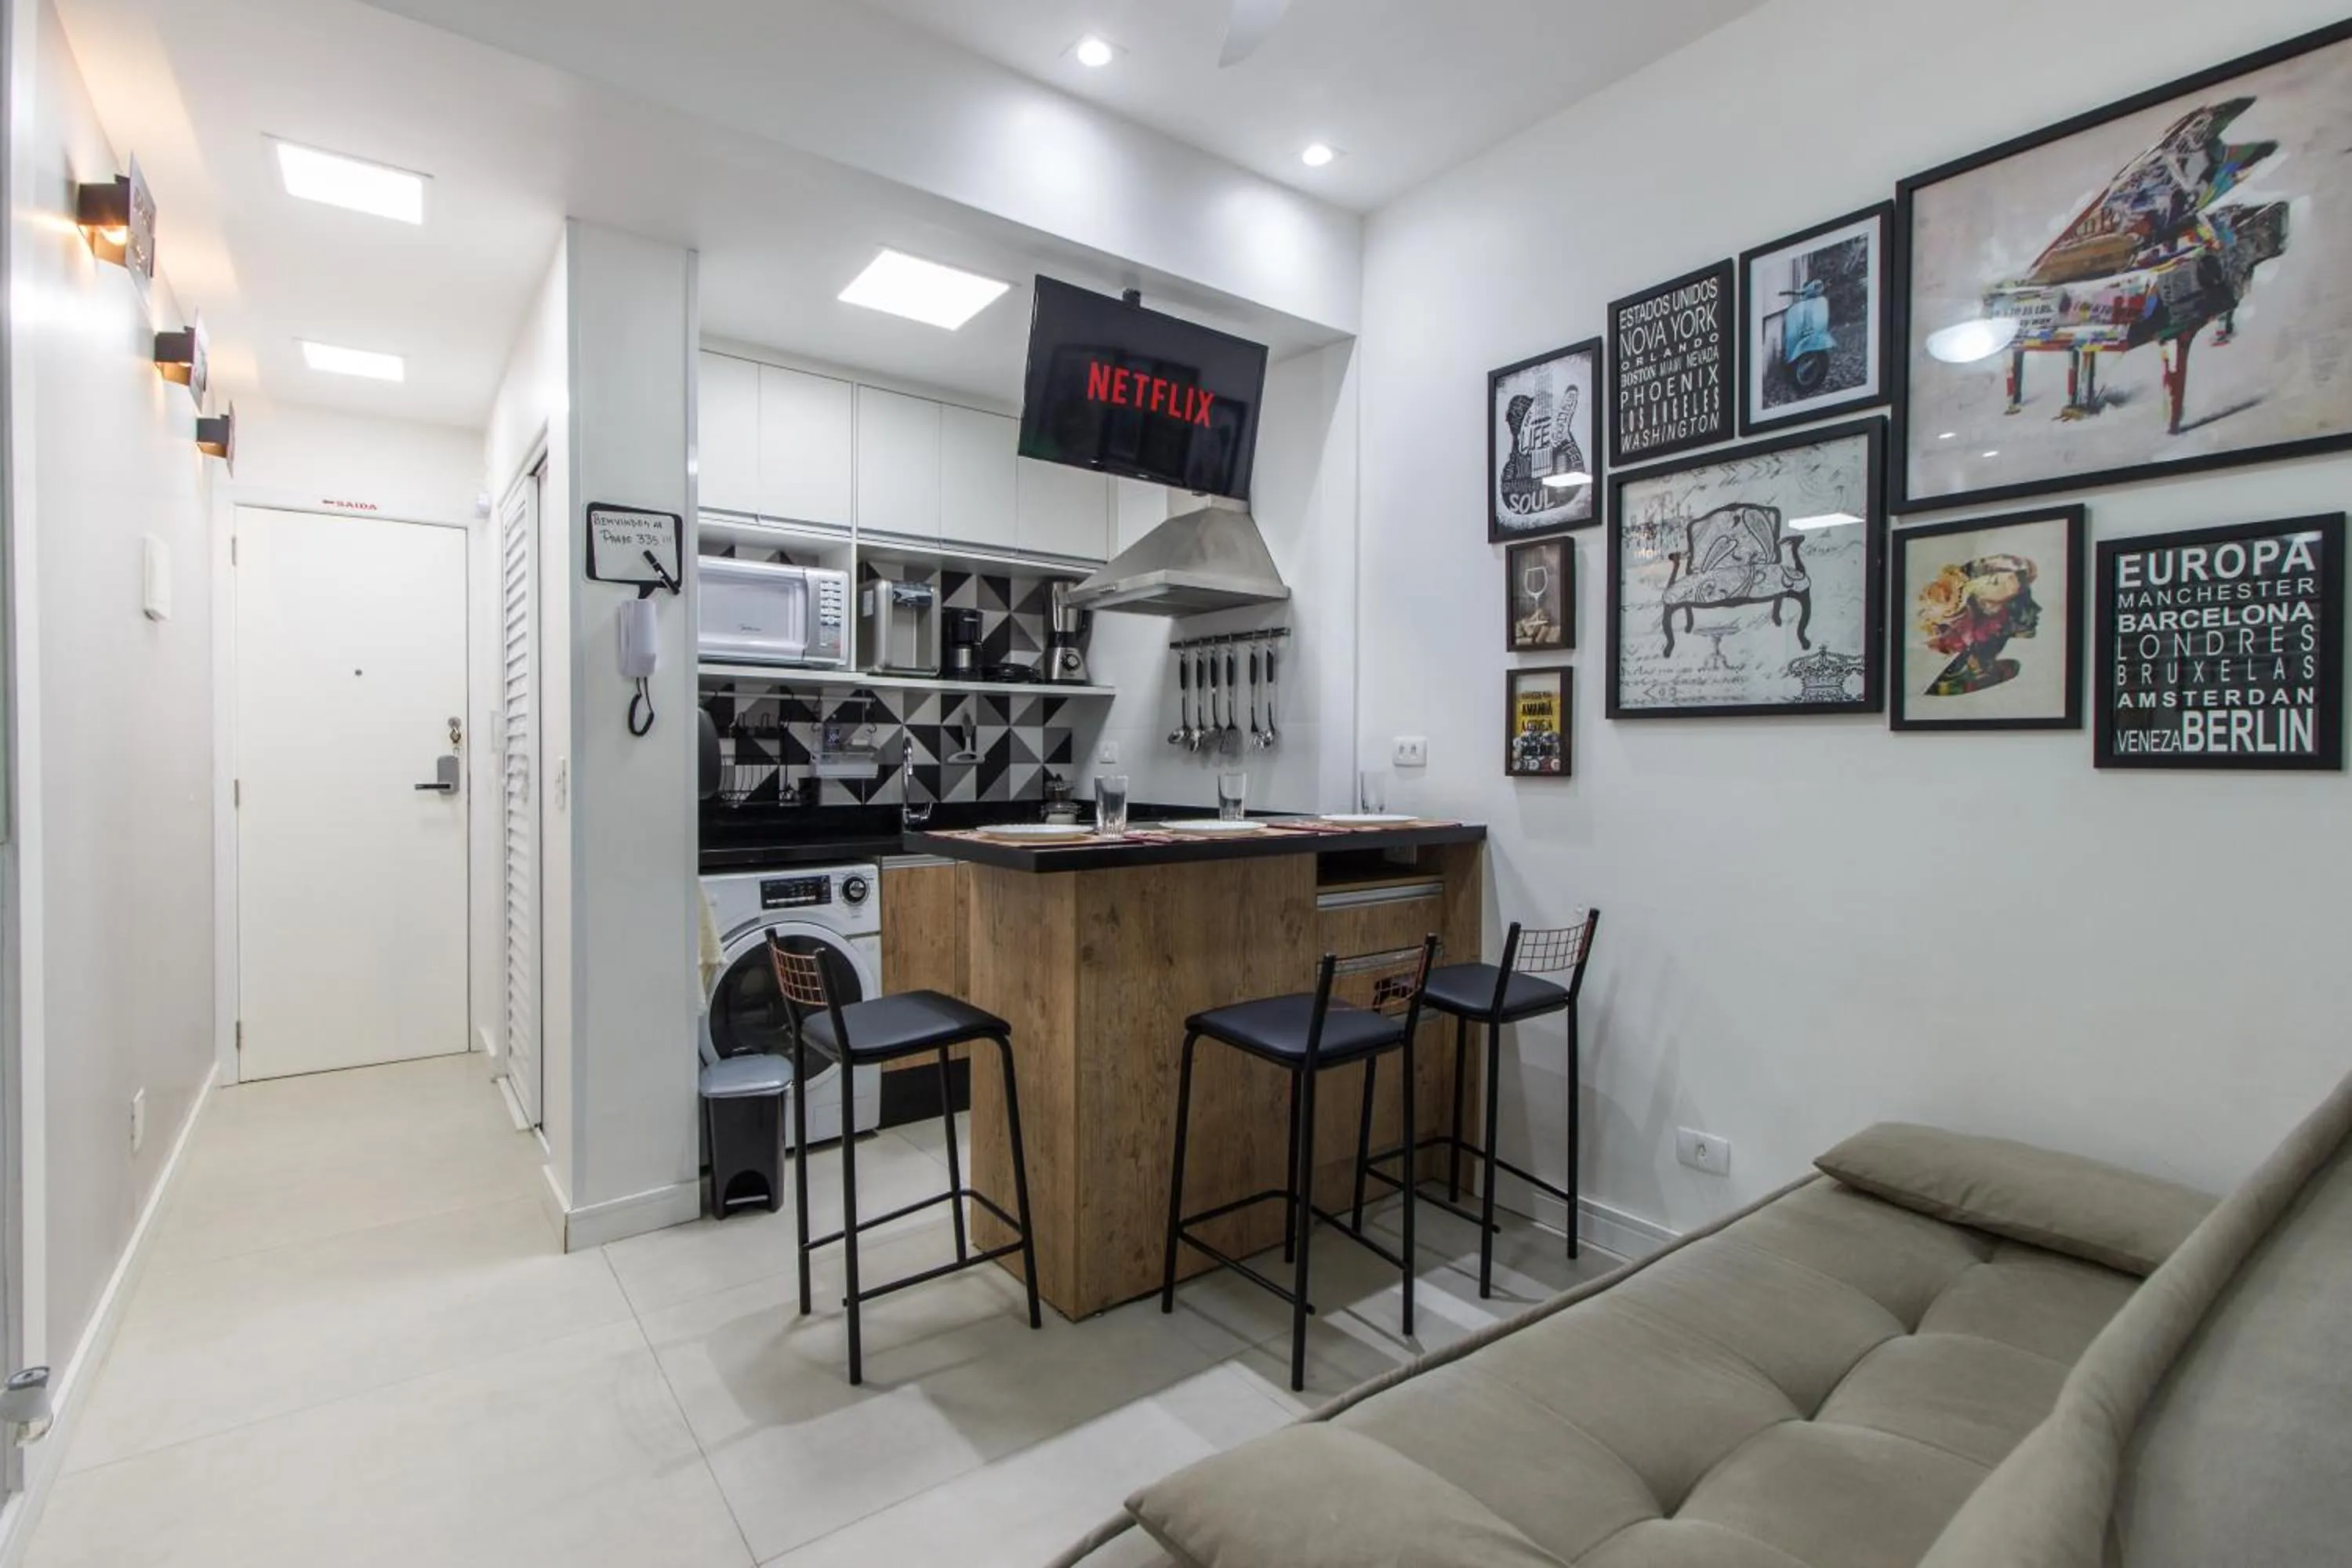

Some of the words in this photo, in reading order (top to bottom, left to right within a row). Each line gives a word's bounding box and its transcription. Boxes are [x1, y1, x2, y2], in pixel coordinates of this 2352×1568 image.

[1619, 295, 1670, 330] ESTADOS
[1672, 277, 1719, 311] UNIDOS
[1620, 320, 1668, 360] NOVA
[1670, 300, 1719, 343] YORK
[1621, 332, 1719, 372] ORLANDO
[1621, 364, 1657, 388] BOSTON
[1686, 345, 1719, 368] NEVADA
[1087, 361, 1215, 427] NETFLIX
[1621, 363, 1719, 410] PHOENIX
[1521, 422, 1552, 452] LIFE
[1621, 412, 1720, 454] WASHINGTON
[1509, 487, 1555, 514] SOUL
[636, 533, 659, 546] 335
[2118, 538, 2316, 589] EUROPA
[2118, 578, 2314, 609] MANCHESTER
[2118, 601, 2315, 633] BARCELONA
[2118, 623, 2314, 661] LONDRES
[2118, 655, 2314, 686] BRUXELAS
[2118, 687, 2314, 709] AMSTERDAN
[2117, 730, 2182, 753] VENEZA
[2182, 708, 2314, 753] BERLIN
